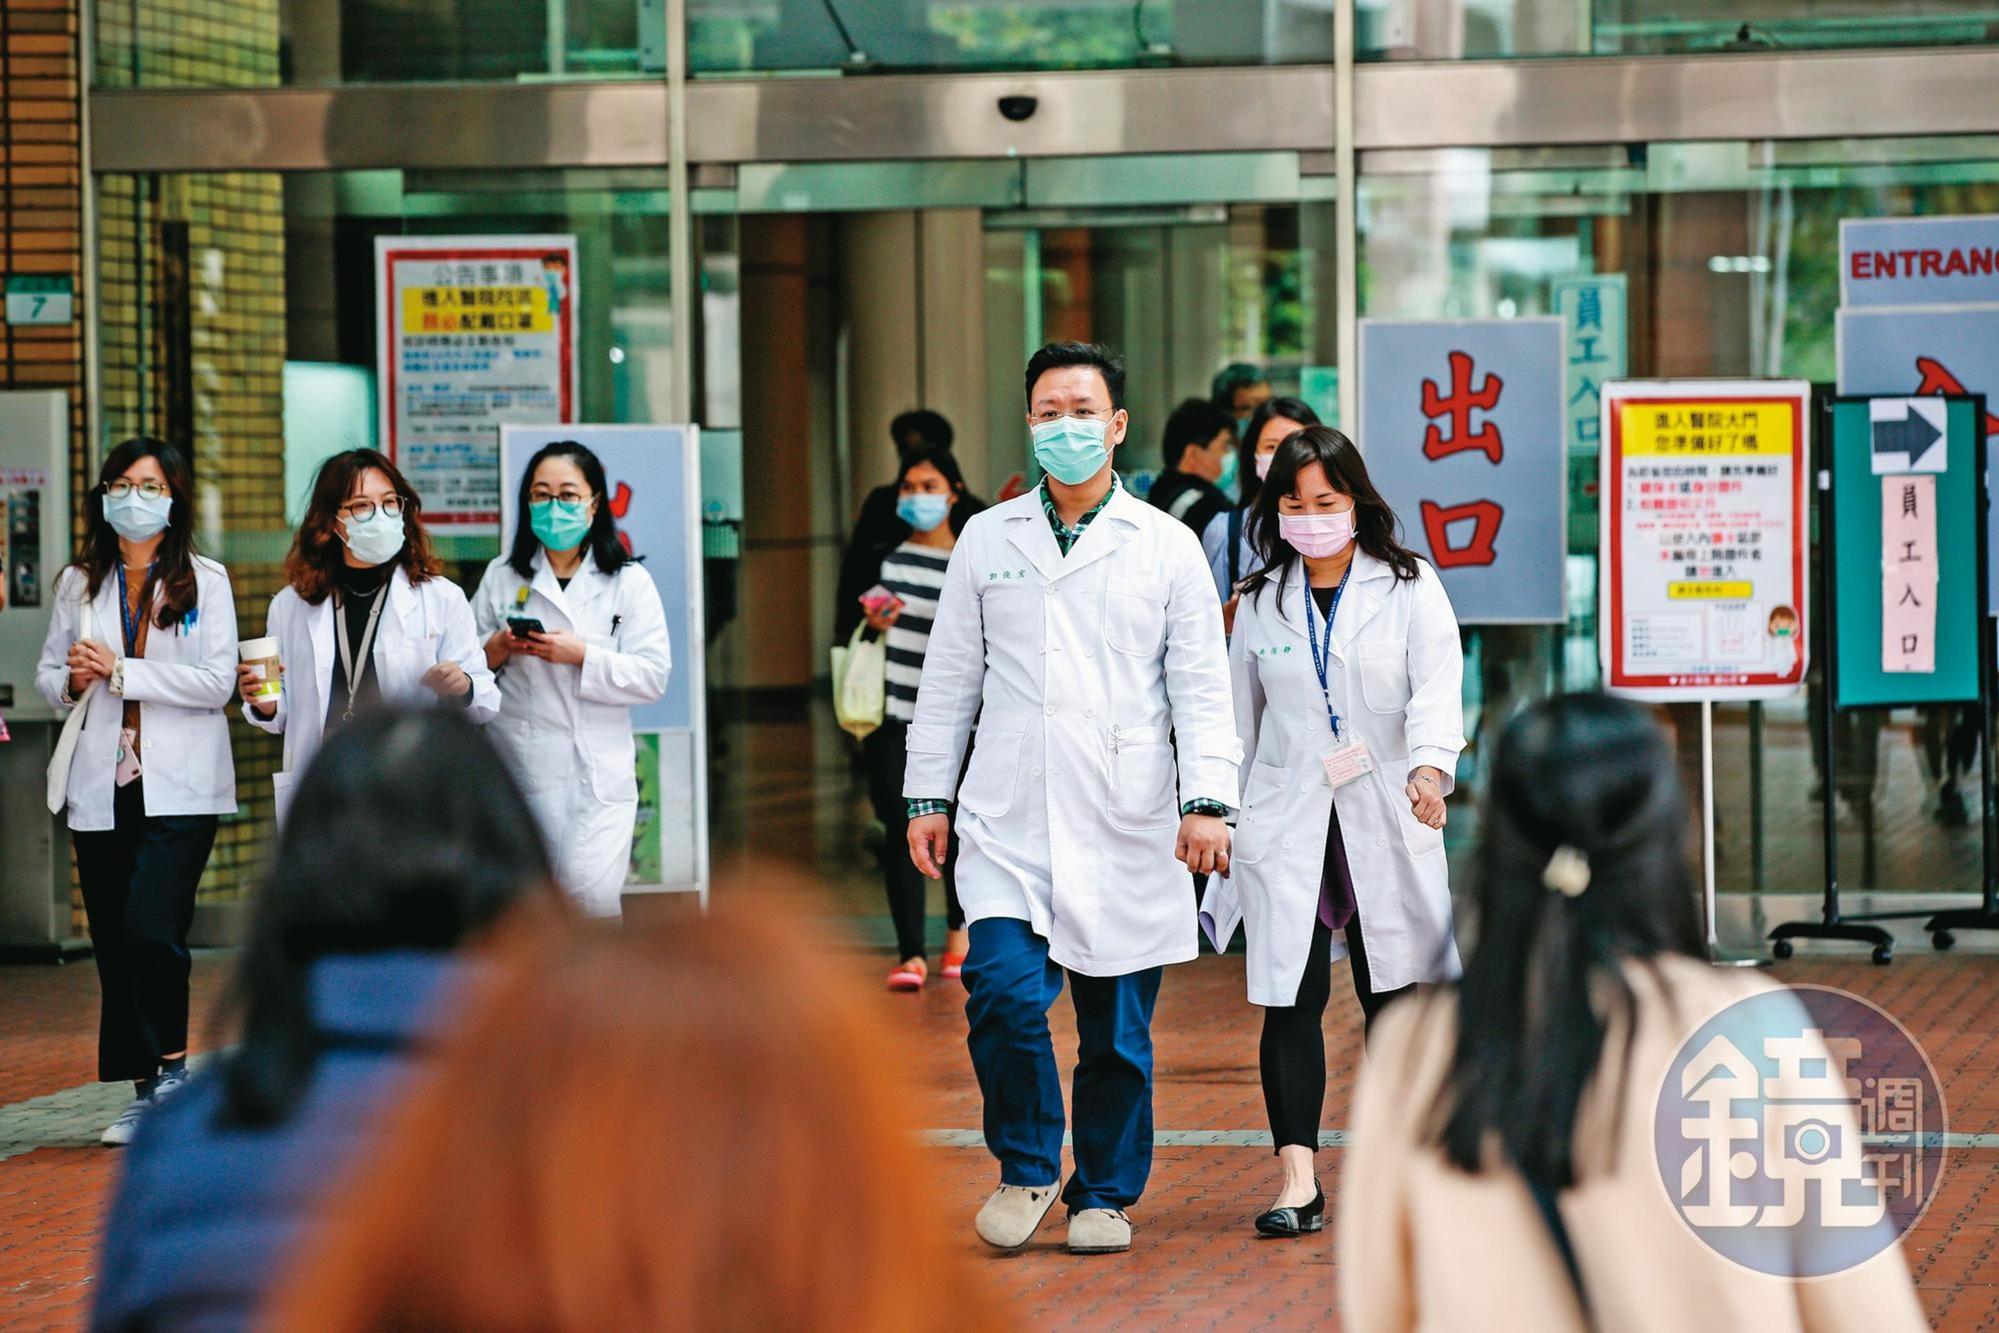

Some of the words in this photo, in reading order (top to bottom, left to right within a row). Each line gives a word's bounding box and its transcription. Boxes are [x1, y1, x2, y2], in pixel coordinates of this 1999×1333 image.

[1851, 247, 1999, 280] ENTRAN
[31, 296, 47, 319] 7
[1655, 411, 1759, 430] 進入醫院大門
[1419, 350, 1504, 570] 出口
[1899, 483, 1922, 655] 員工入口
